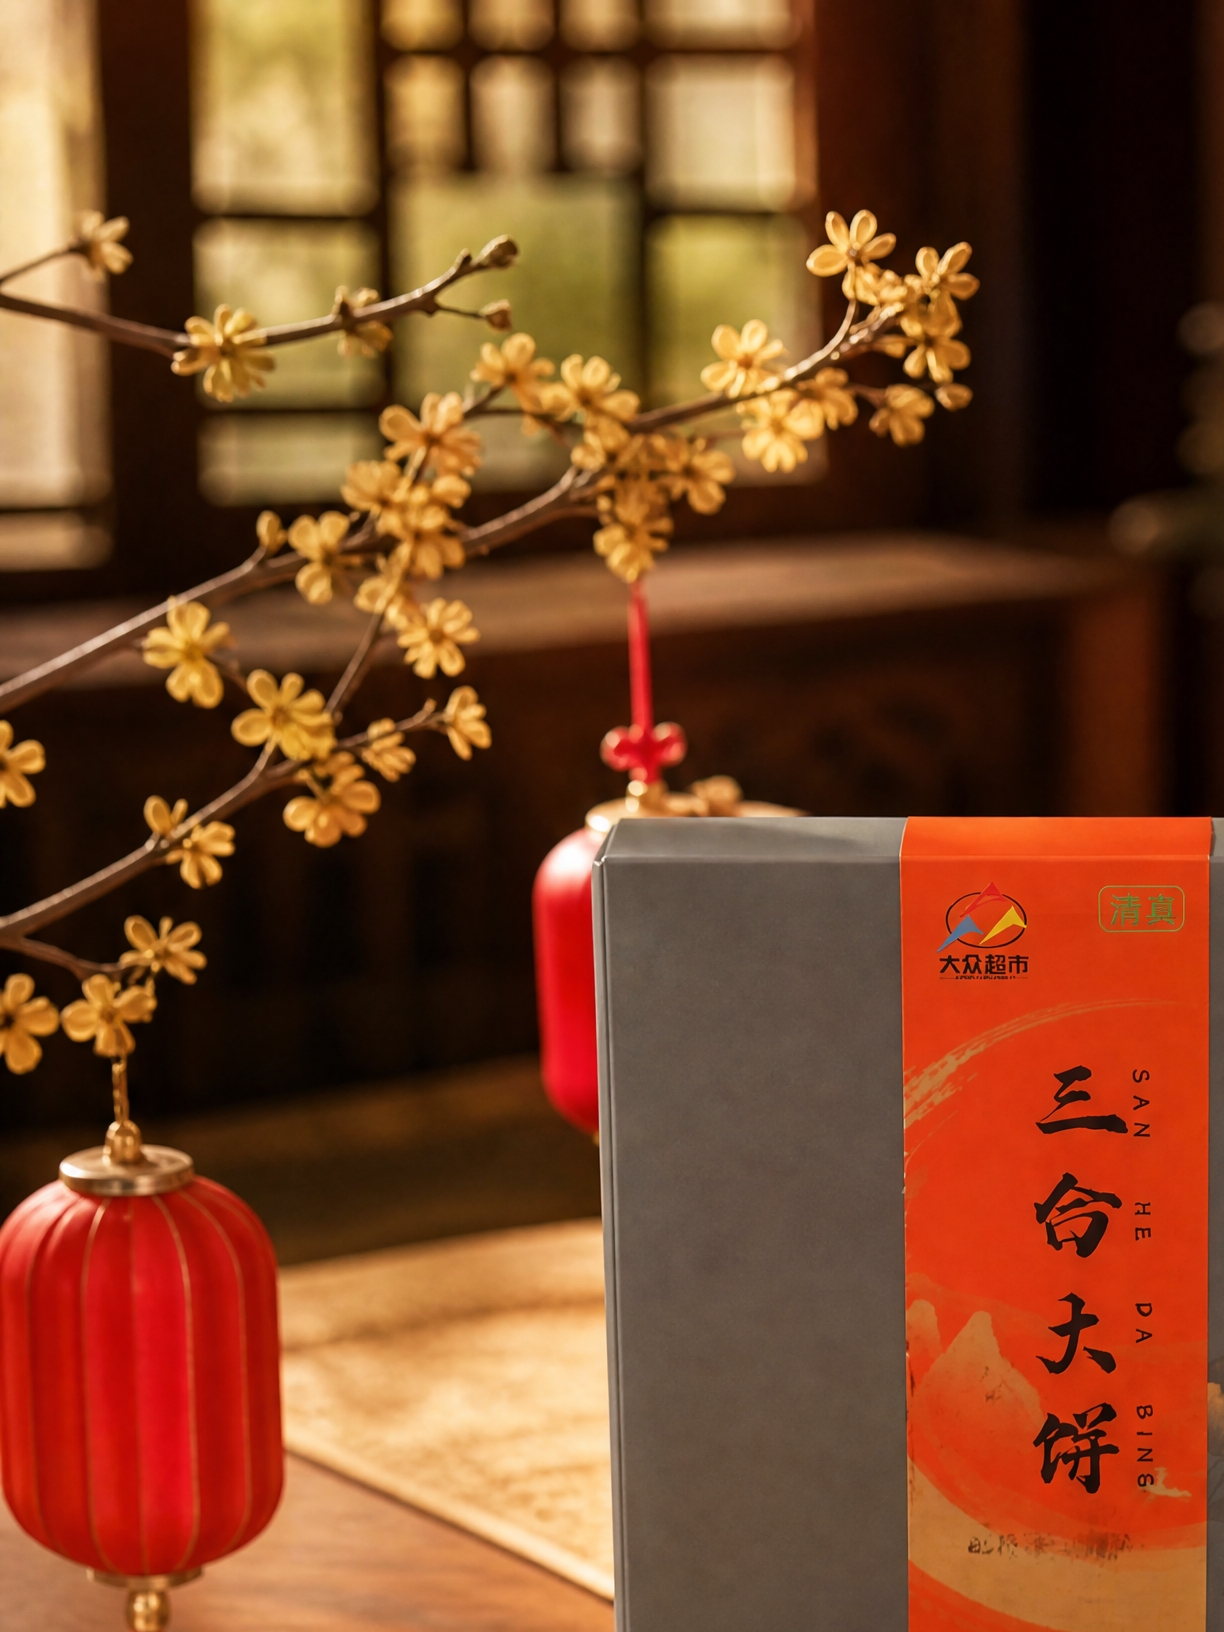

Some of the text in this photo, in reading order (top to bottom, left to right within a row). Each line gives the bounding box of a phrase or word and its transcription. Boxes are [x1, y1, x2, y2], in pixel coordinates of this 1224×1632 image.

[1110, 892, 1176, 927] 清真
[939, 954, 1029, 975] 大众超市
[1132, 1069, 1151, 1138] SAN
[1134, 1202, 1152, 1241] HE
[1033, 1065, 1129, 1494] 三合大饼
[1135, 1302, 1153, 1343] DA
